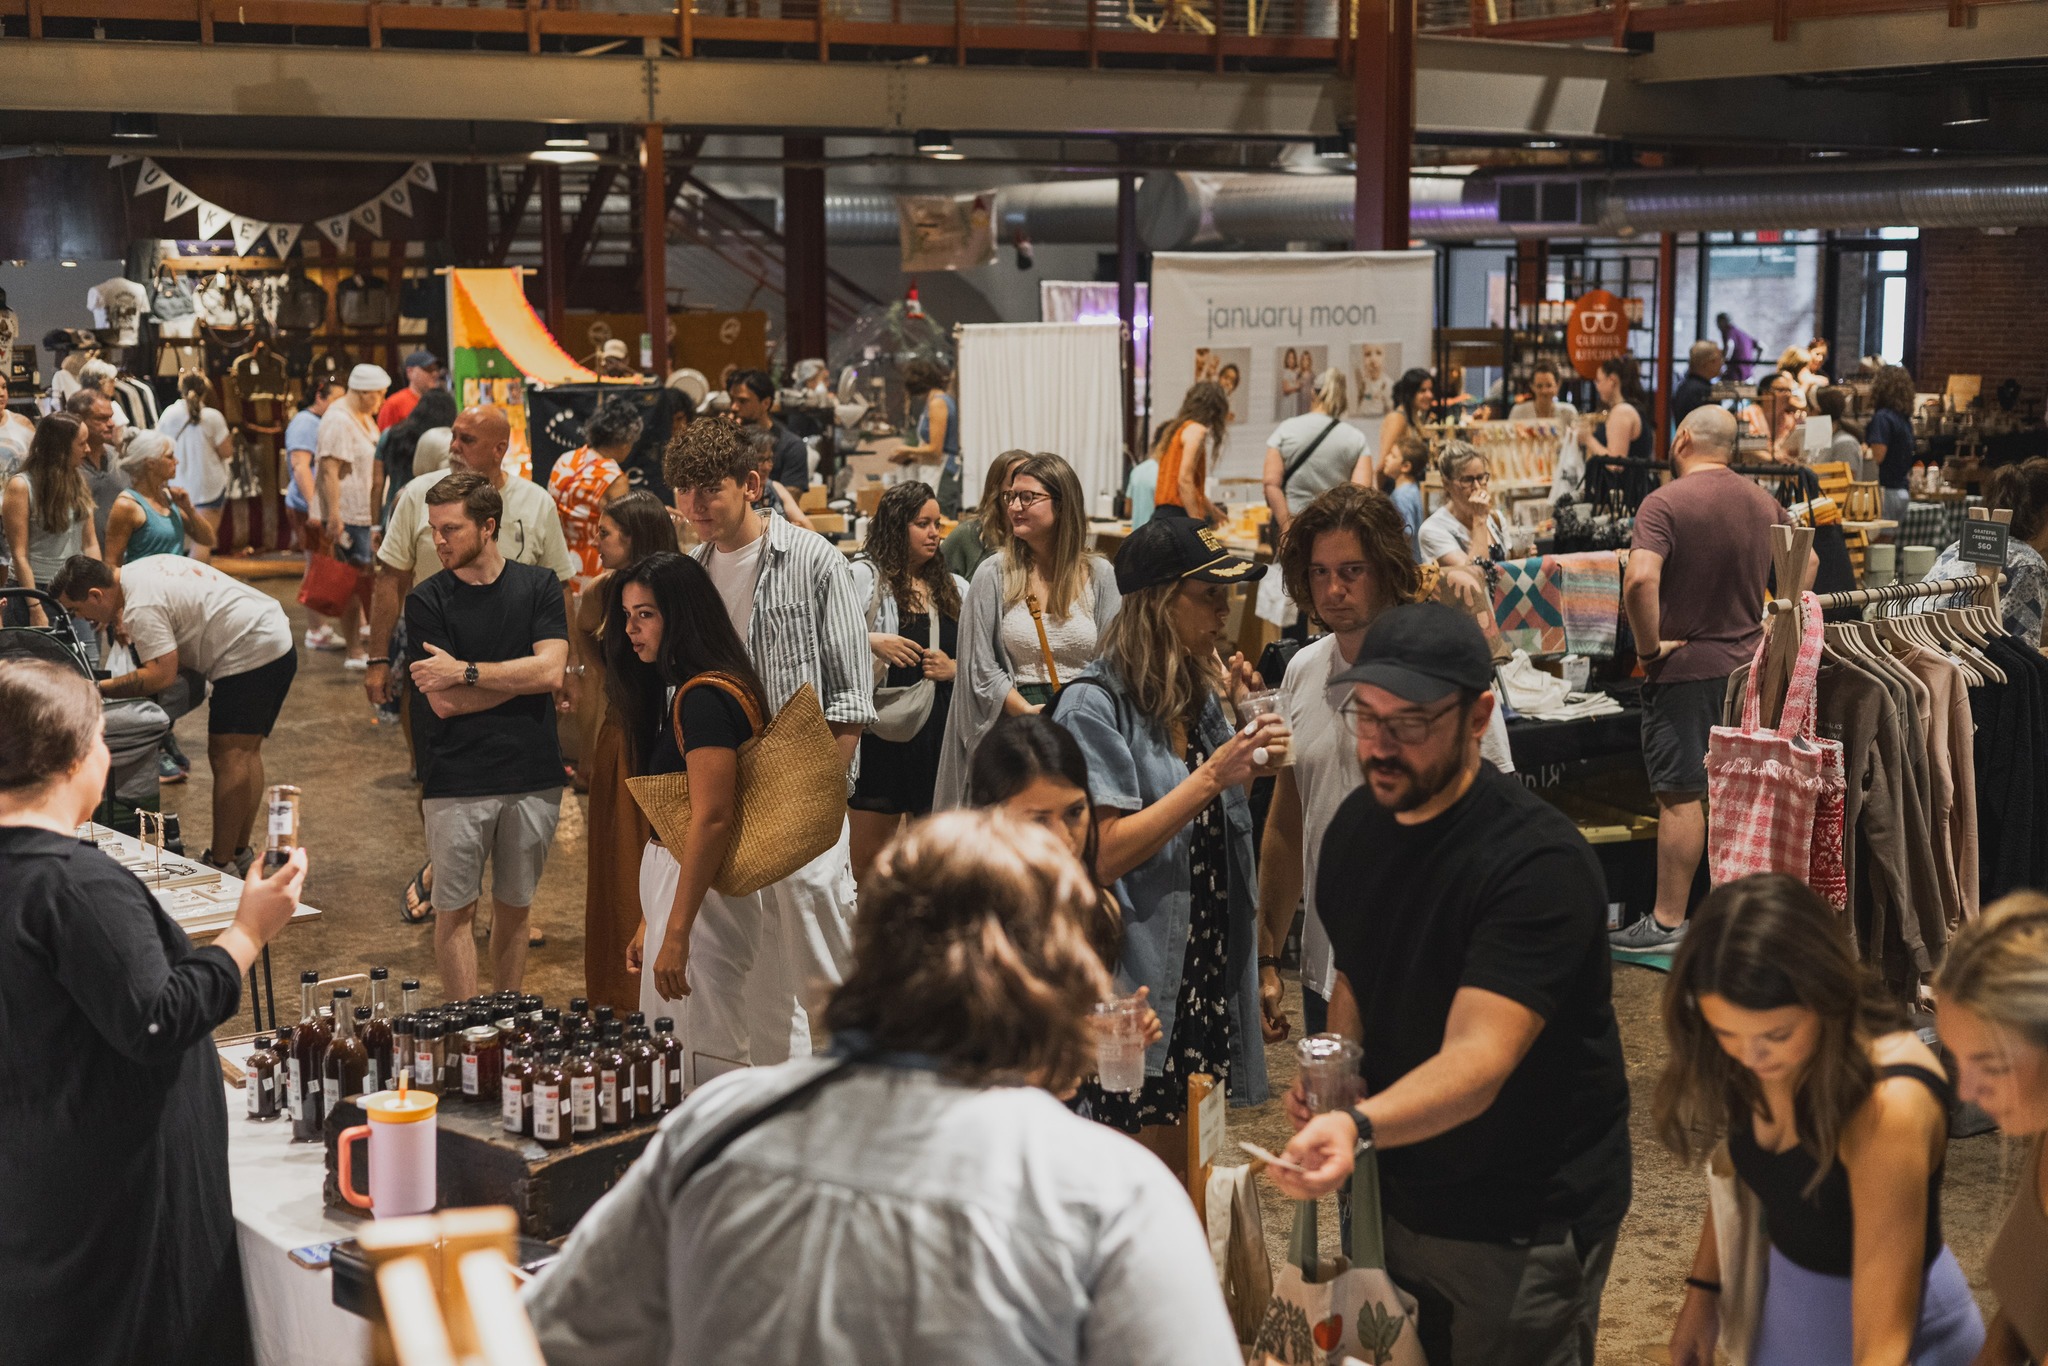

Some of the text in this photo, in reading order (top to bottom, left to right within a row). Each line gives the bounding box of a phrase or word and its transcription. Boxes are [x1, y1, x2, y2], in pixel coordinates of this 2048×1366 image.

[121, 155, 289, 246] UNKER
[1207, 297, 1377, 340] january moon
[1973, 528, 1997, 536] GRATEFUL
[1972, 534, 1998, 542] CREWNECK
[1977, 542, 1992, 551] $60
